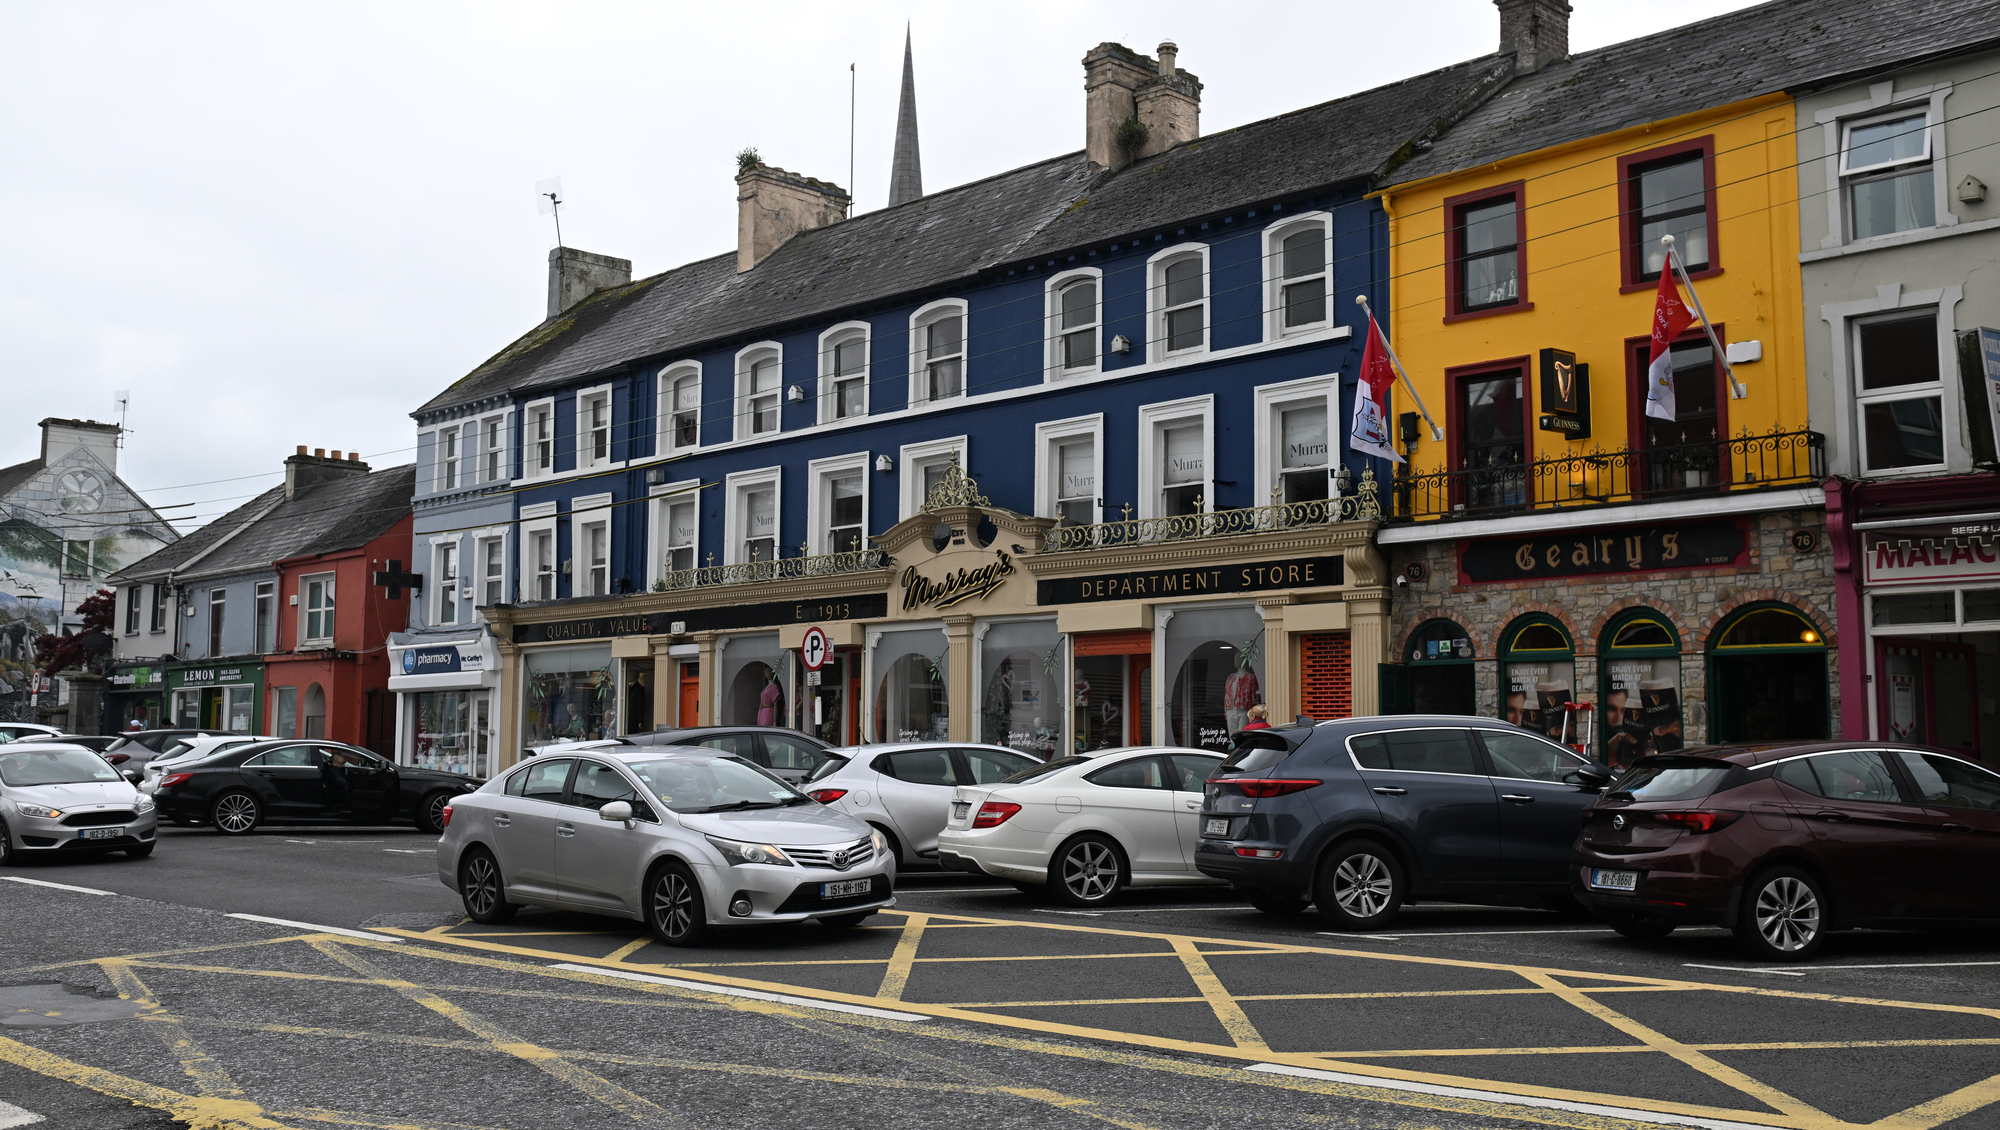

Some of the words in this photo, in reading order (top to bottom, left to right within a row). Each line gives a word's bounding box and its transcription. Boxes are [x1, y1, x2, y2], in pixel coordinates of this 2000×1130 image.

[1656, 308, 1669, 329] Cork
[1553, 417, 1580, 430] GUINNESS
[1290, 443, 1328, 457] Murra
[1951, 525, 1980, 535] BEEF
[1796, 535, 1810, 547] 76
[1515, 530, 1679, 570] Geary's
[1876, 538, 2000, 569] MALAC
[1409, 566, 1420, 576] 76
[901, 549, 1016, 611] Murray's
[1082, 571, 1222, 598] DEPARTMENT
[1242, 563, 1315, 587] STORE
[796, 605, 802, 619] E
[819, 604, 850, 620] 1913
[547, 622, 601, 641] QUALITY,
[610, 618, 648, 633] VALUE
[811, 635, 820, 662] P
[405, 654, 413, 665] life
[418, 653, 452, 666] pharmacy
[1511, 668, 1529, 676] ENJOY
[1612, 665, 1631, 673] ENJOY
[184, 669, 215, 681] LEMON
[1511, 676, 1531, 684] MATCH
[1635, 673, 1641, 681] AT
[1511, 684, 1534, 692] GEARY'S
[1612, 682, 1637, 690] GEARY'S
[1646, 703, 1670, 714] GUINNESS
[899, 728, 913, 737] Spring
[1007, 730, 1024, 740] Spring
[1199, 727, 1218, 738] Spring
[1219, 727, 1226, 735] in
[1008, 739, 1021, 748] your
[1201, 736, 1215, 746] your
[89, 829, 118, 840] 182-D-1951
[1601, 873, 1632, 886] 181-C-8660
[830, 881, 868, 895] 151-MH-1197
